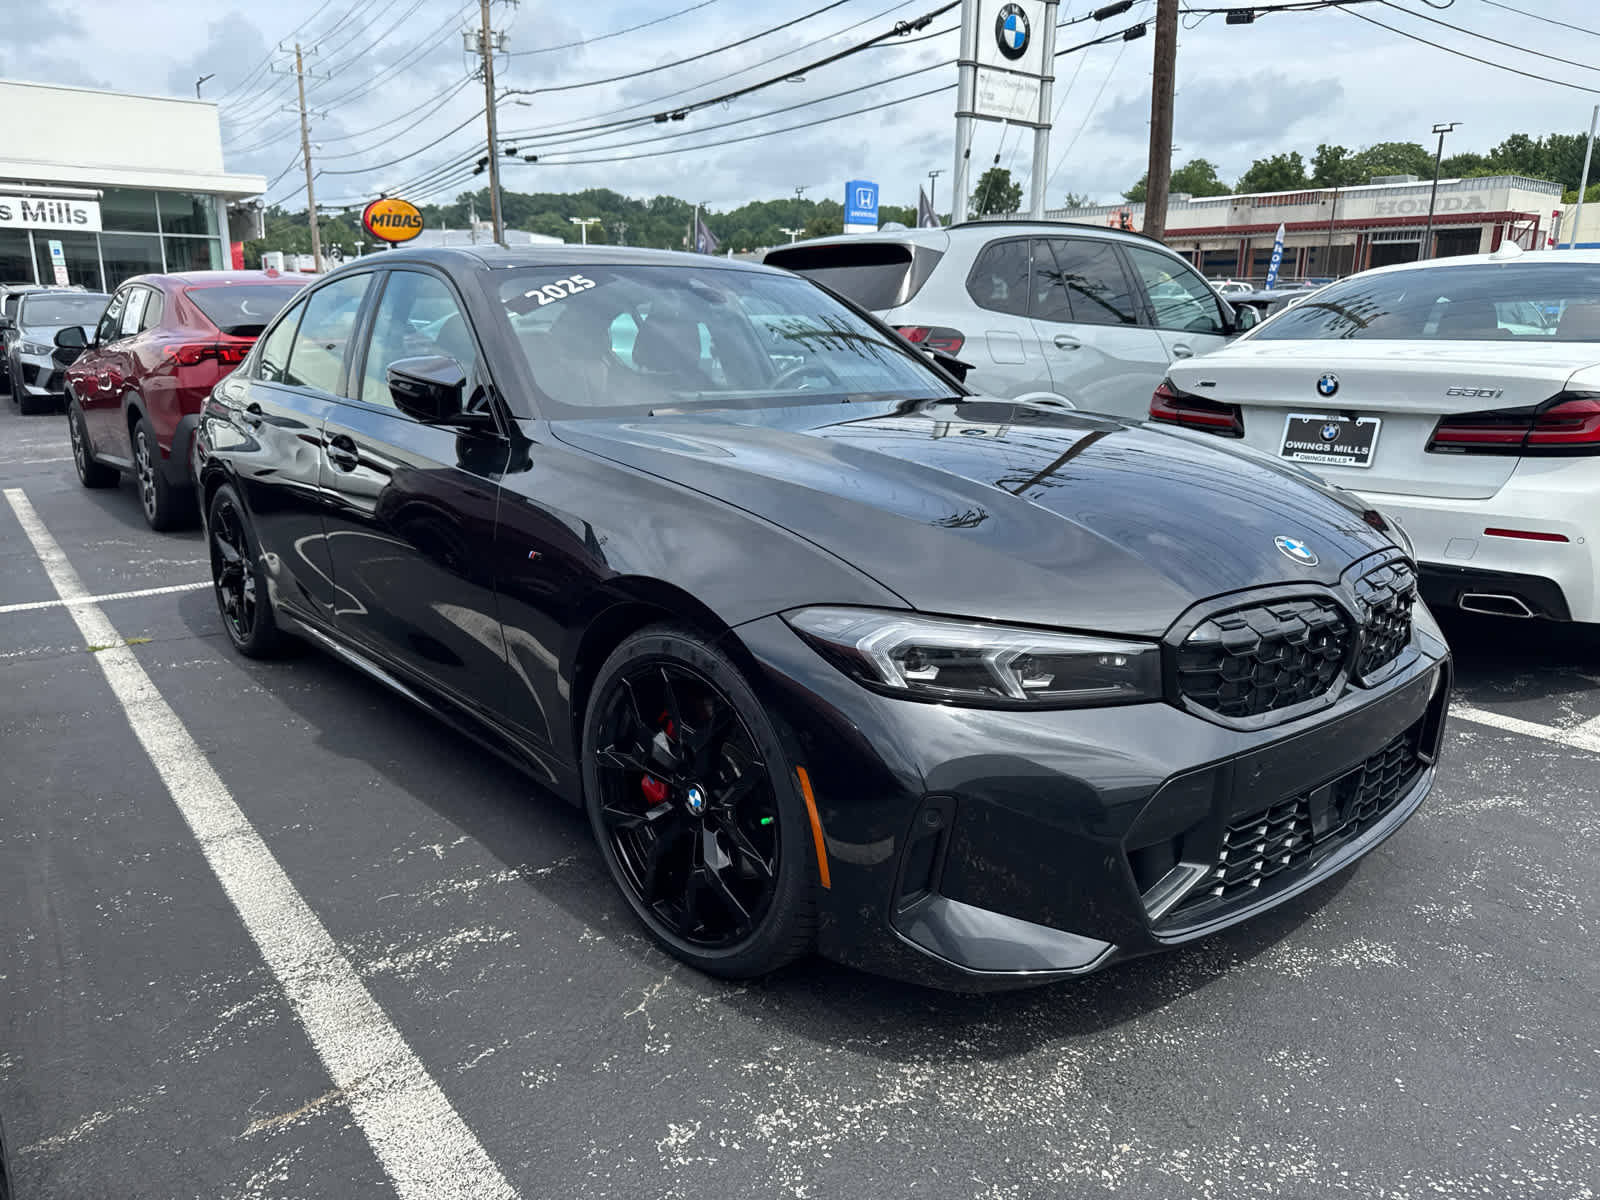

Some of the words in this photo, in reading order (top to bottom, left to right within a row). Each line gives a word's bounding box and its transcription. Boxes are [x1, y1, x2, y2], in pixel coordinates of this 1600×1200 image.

[21, 200, 88, 224] Mills
[1375, 195, 1487, 215] HONDA
[370, 213, 422, 228] MIDAS
[525, 274, 596, 305] 2025
[1285, 440, 1331, 453] OWINGS
[1333, 443, 1369, 455] MILLS
